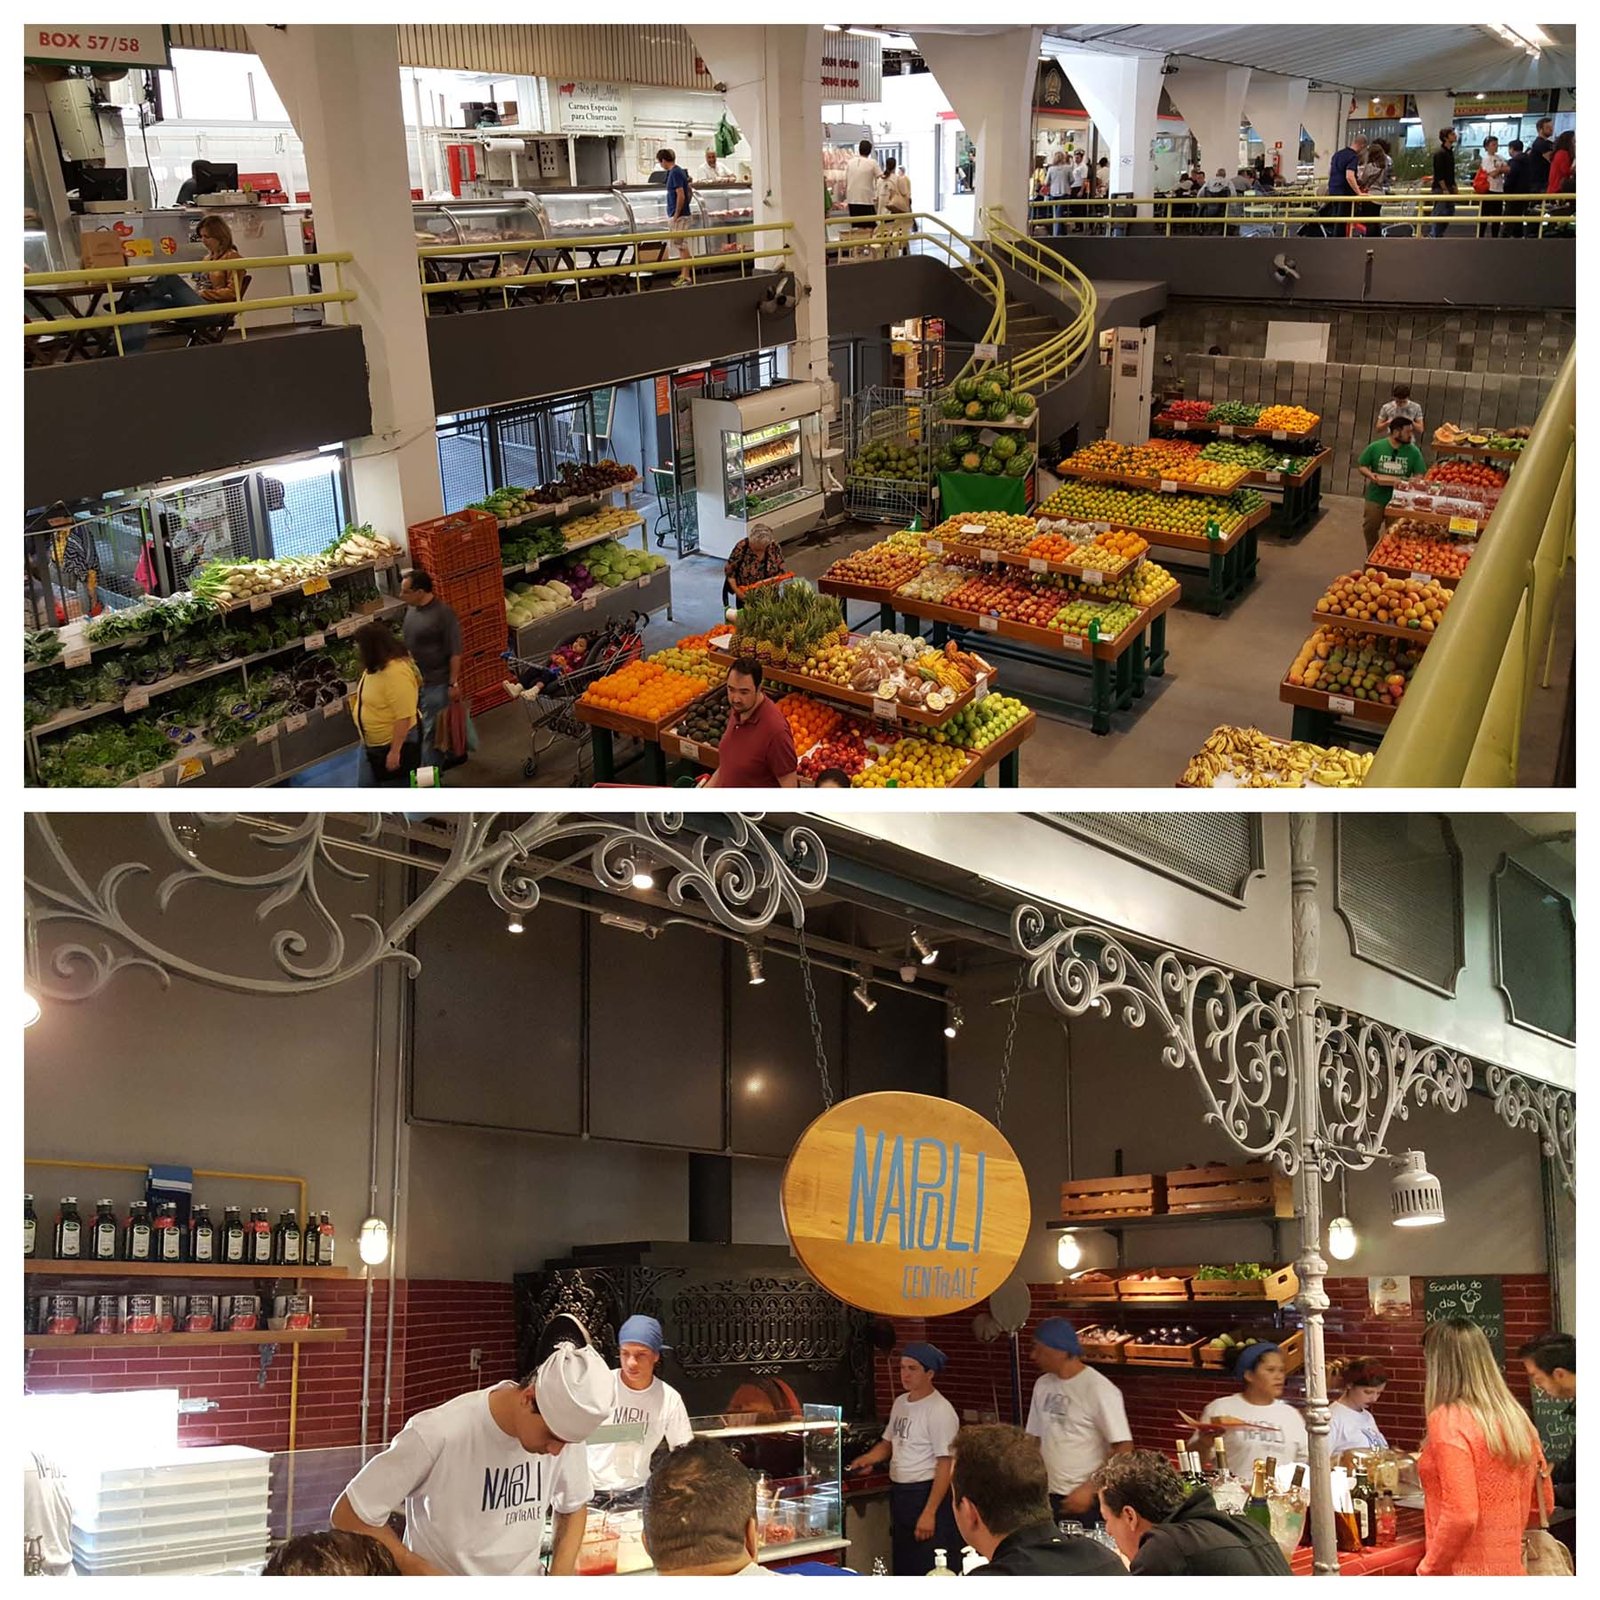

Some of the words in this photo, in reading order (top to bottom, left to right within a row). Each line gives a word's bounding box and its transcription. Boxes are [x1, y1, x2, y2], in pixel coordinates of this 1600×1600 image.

[39, 31, 81, 48] BOX
[87, 36, 140, 52] 57/58
[568, 102, 590, 110] Carnes
[590, 103, 618, 113] Especiais
[585, 113, 617, 121] Churrasco
[846, 1124, 985, 1254] NAPOLI
[902, 1256, 979, 1300] CENTRALE
[1470, 1280, 1482, 1289] do
[481, 1460, 541, 1512] NAPOLI
[505, 1506, 541, 1527] CENTRALE
